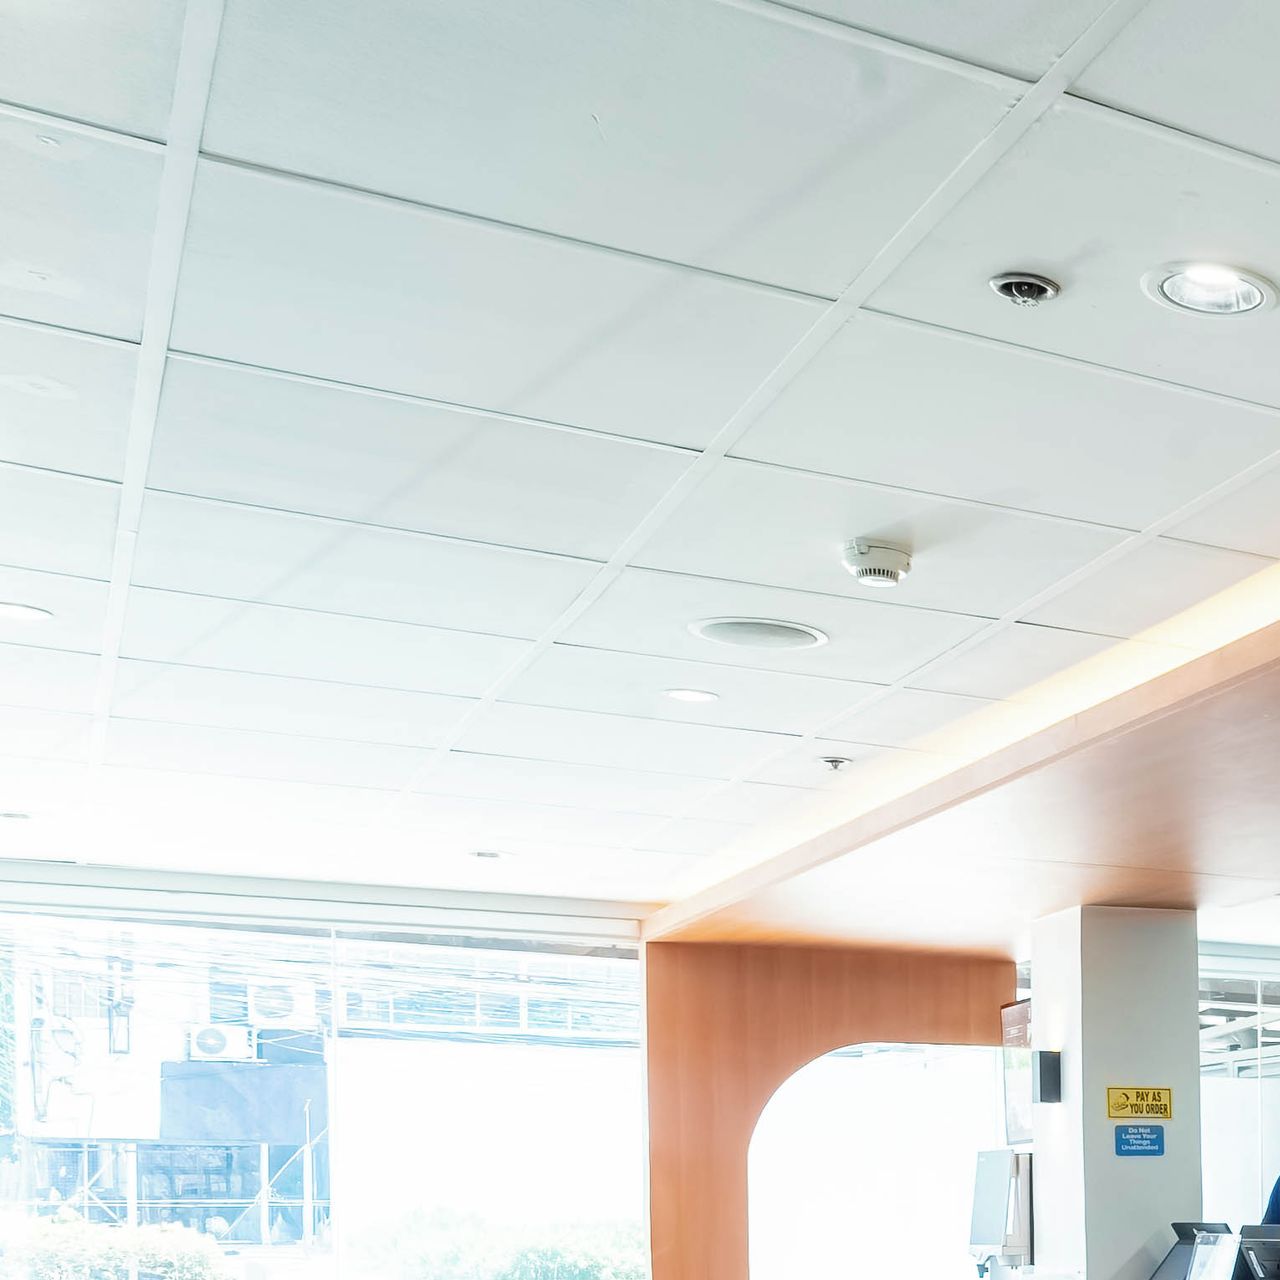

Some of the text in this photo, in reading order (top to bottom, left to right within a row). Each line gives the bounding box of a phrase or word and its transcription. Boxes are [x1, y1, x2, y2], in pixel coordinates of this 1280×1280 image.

[1136, 1091, 1162, 1102] PAY AS
[1129, 1103, 1168, 1114] YOU ORDER
